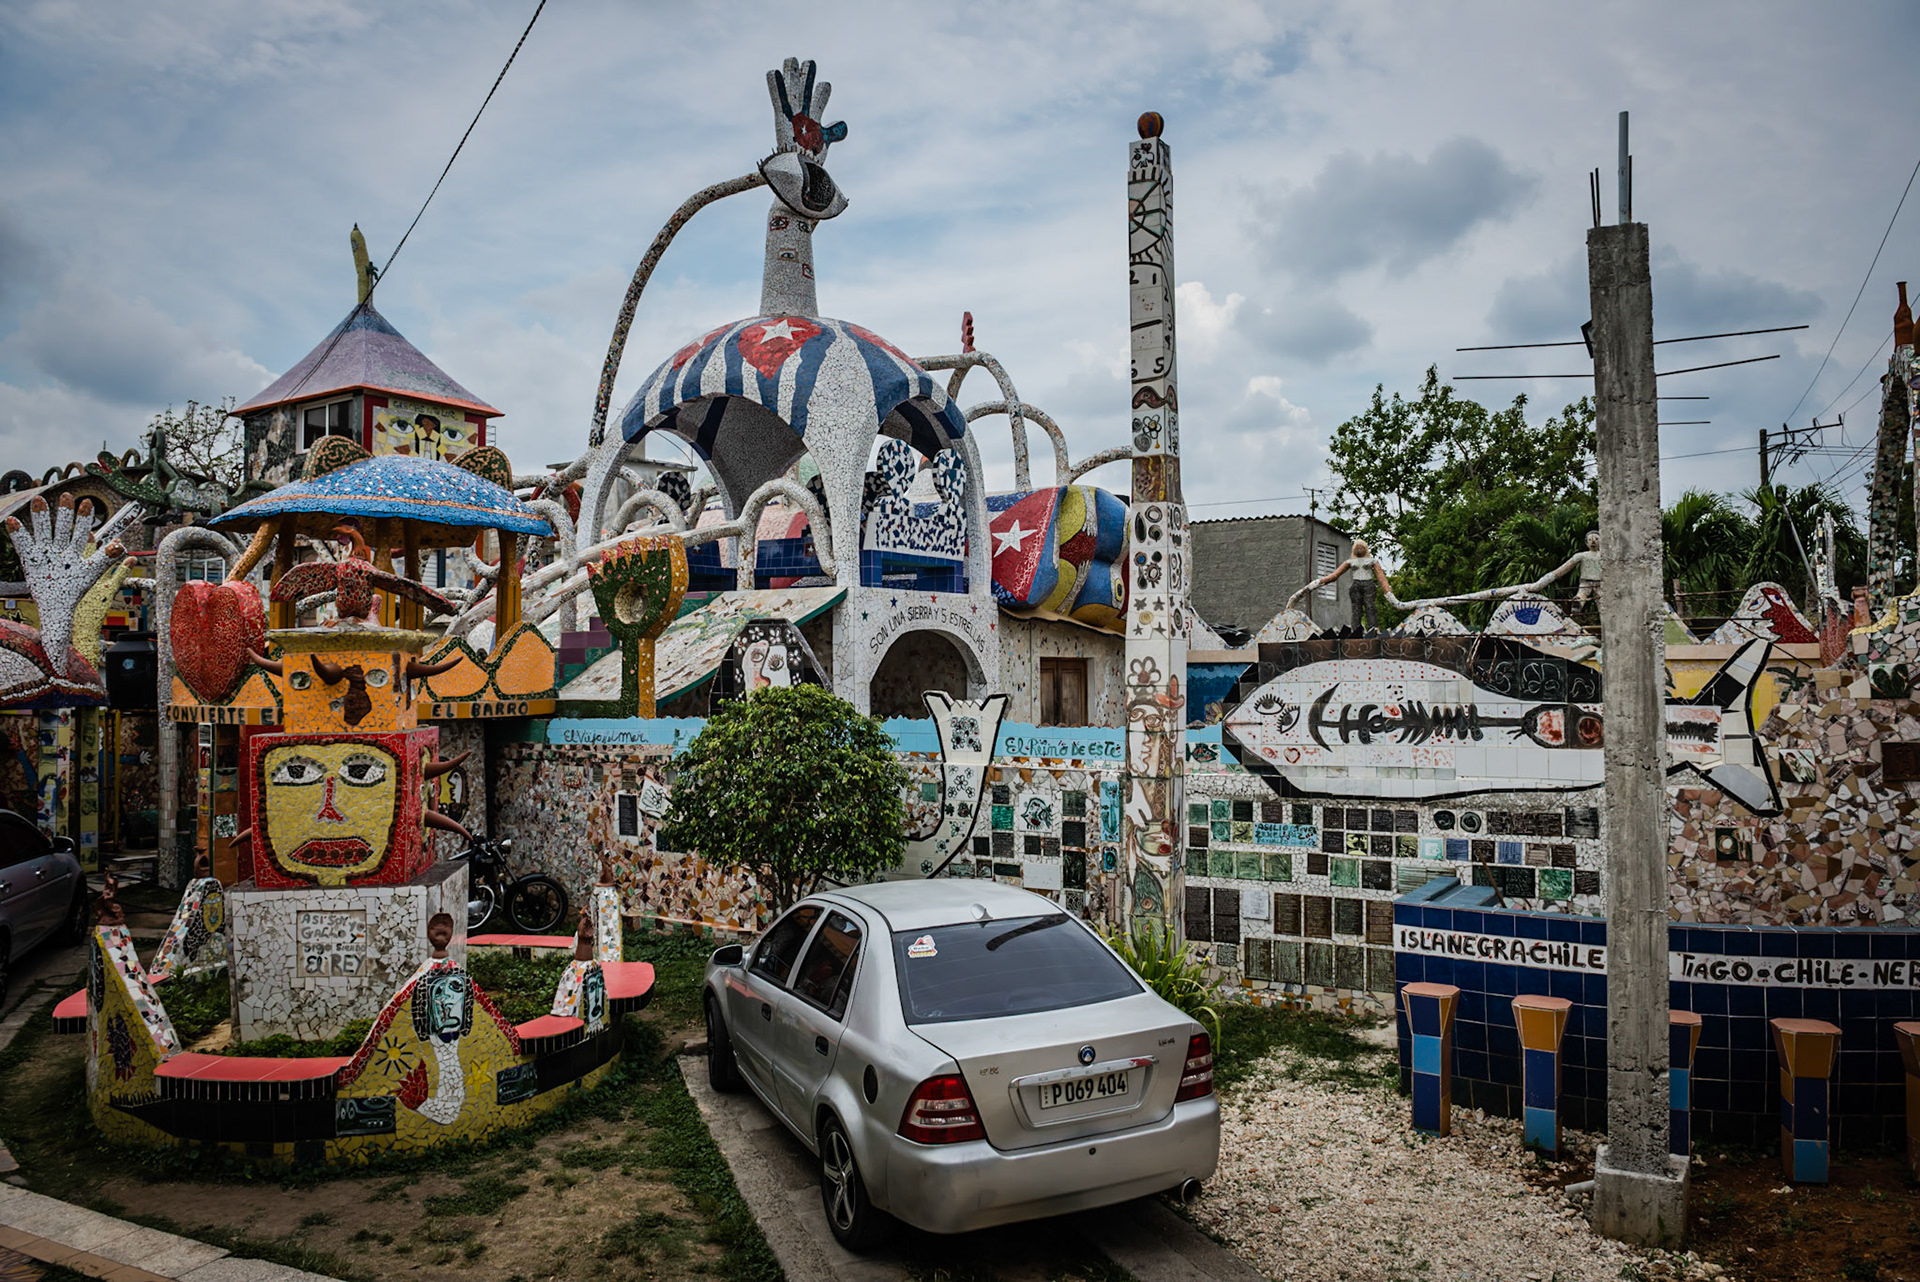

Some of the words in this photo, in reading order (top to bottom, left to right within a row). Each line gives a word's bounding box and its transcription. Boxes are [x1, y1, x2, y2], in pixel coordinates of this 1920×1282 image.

[869, 626, 888, 654] SON
[888, 611, 905, 632] UNA
[907, 605, 932, 621] SIERRA
[933, 608, 939, 620] Y
[942, 608, 947, 623] 5
[949, 612, 985, 653] ESTRELLAS
[166, 705, 245, 724] CONVIERTE
[432, 703, 454, 718] EL
[471, 701, 529, 718] BARRO
[1005, 737, 1027, 755] El
[331, 953, 366, 976] REY
